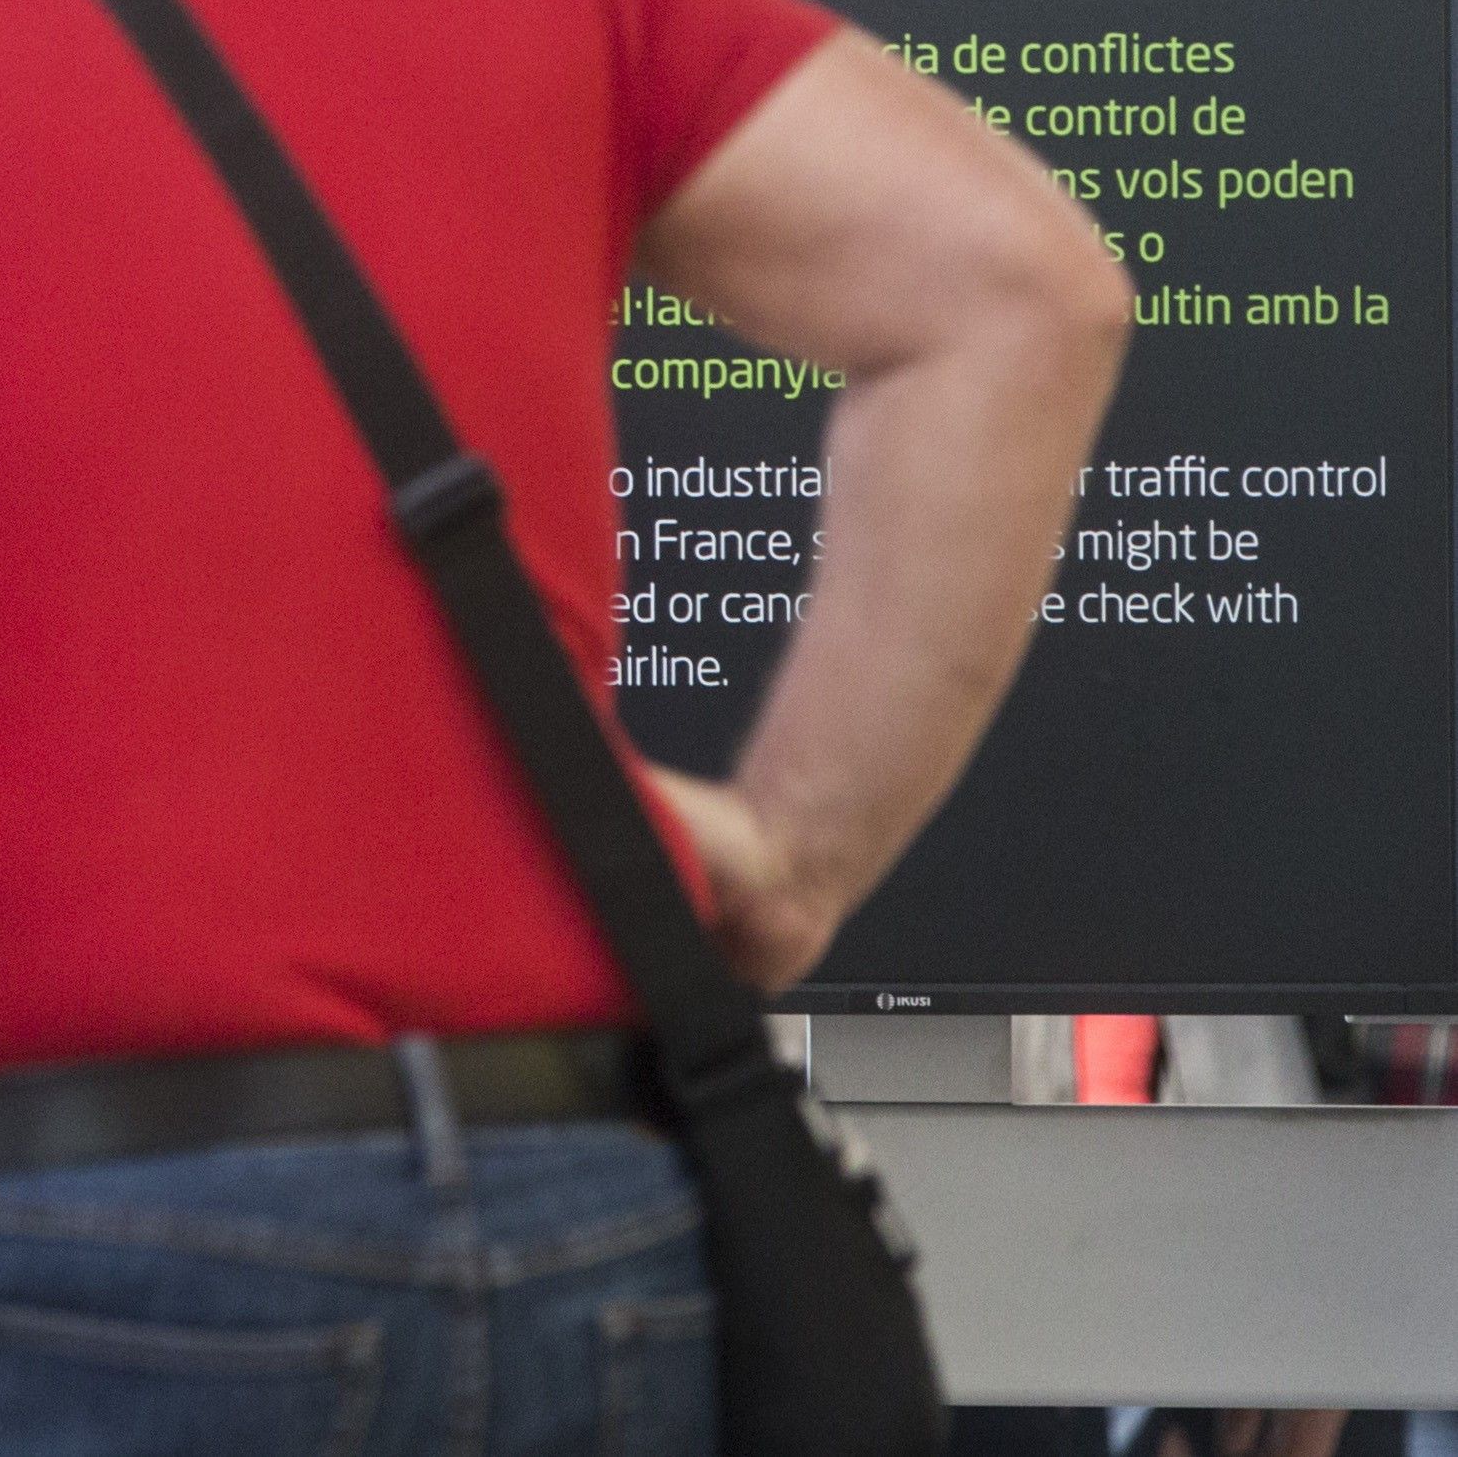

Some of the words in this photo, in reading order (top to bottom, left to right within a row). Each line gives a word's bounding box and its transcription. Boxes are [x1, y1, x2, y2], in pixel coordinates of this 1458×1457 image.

[953, 33, 1006, 74] de
[1020, 32, 1235, 74] conflictes
[1025, 95, 1177, 136] control
[1193, 95, 1246, 136] de
[1115, 159, 1203, 199] vols
[1219, 159, 1354, 209] poden
[1139, 231, 1165, 263] o
[1246, 285, 1339, 325] amb
[1354, 285, 1389, 325] la
[647, 456, 831, 498] industrial
[1104, 454, 1230, 497] traffic
[1242, 455, 1386, 498] control
[654, 518, 800, 566] France,
[1078, 519, 1197, 571] might
[1209, 519, 1259, 561] be
[668, 592, 709, 623] or
[1078, 582, 1195, 624] check
[1206, 582, 1298, 624] with
[605, 645, 729, 687] airline.
[896, 995, 931, 1007] IKUSI
